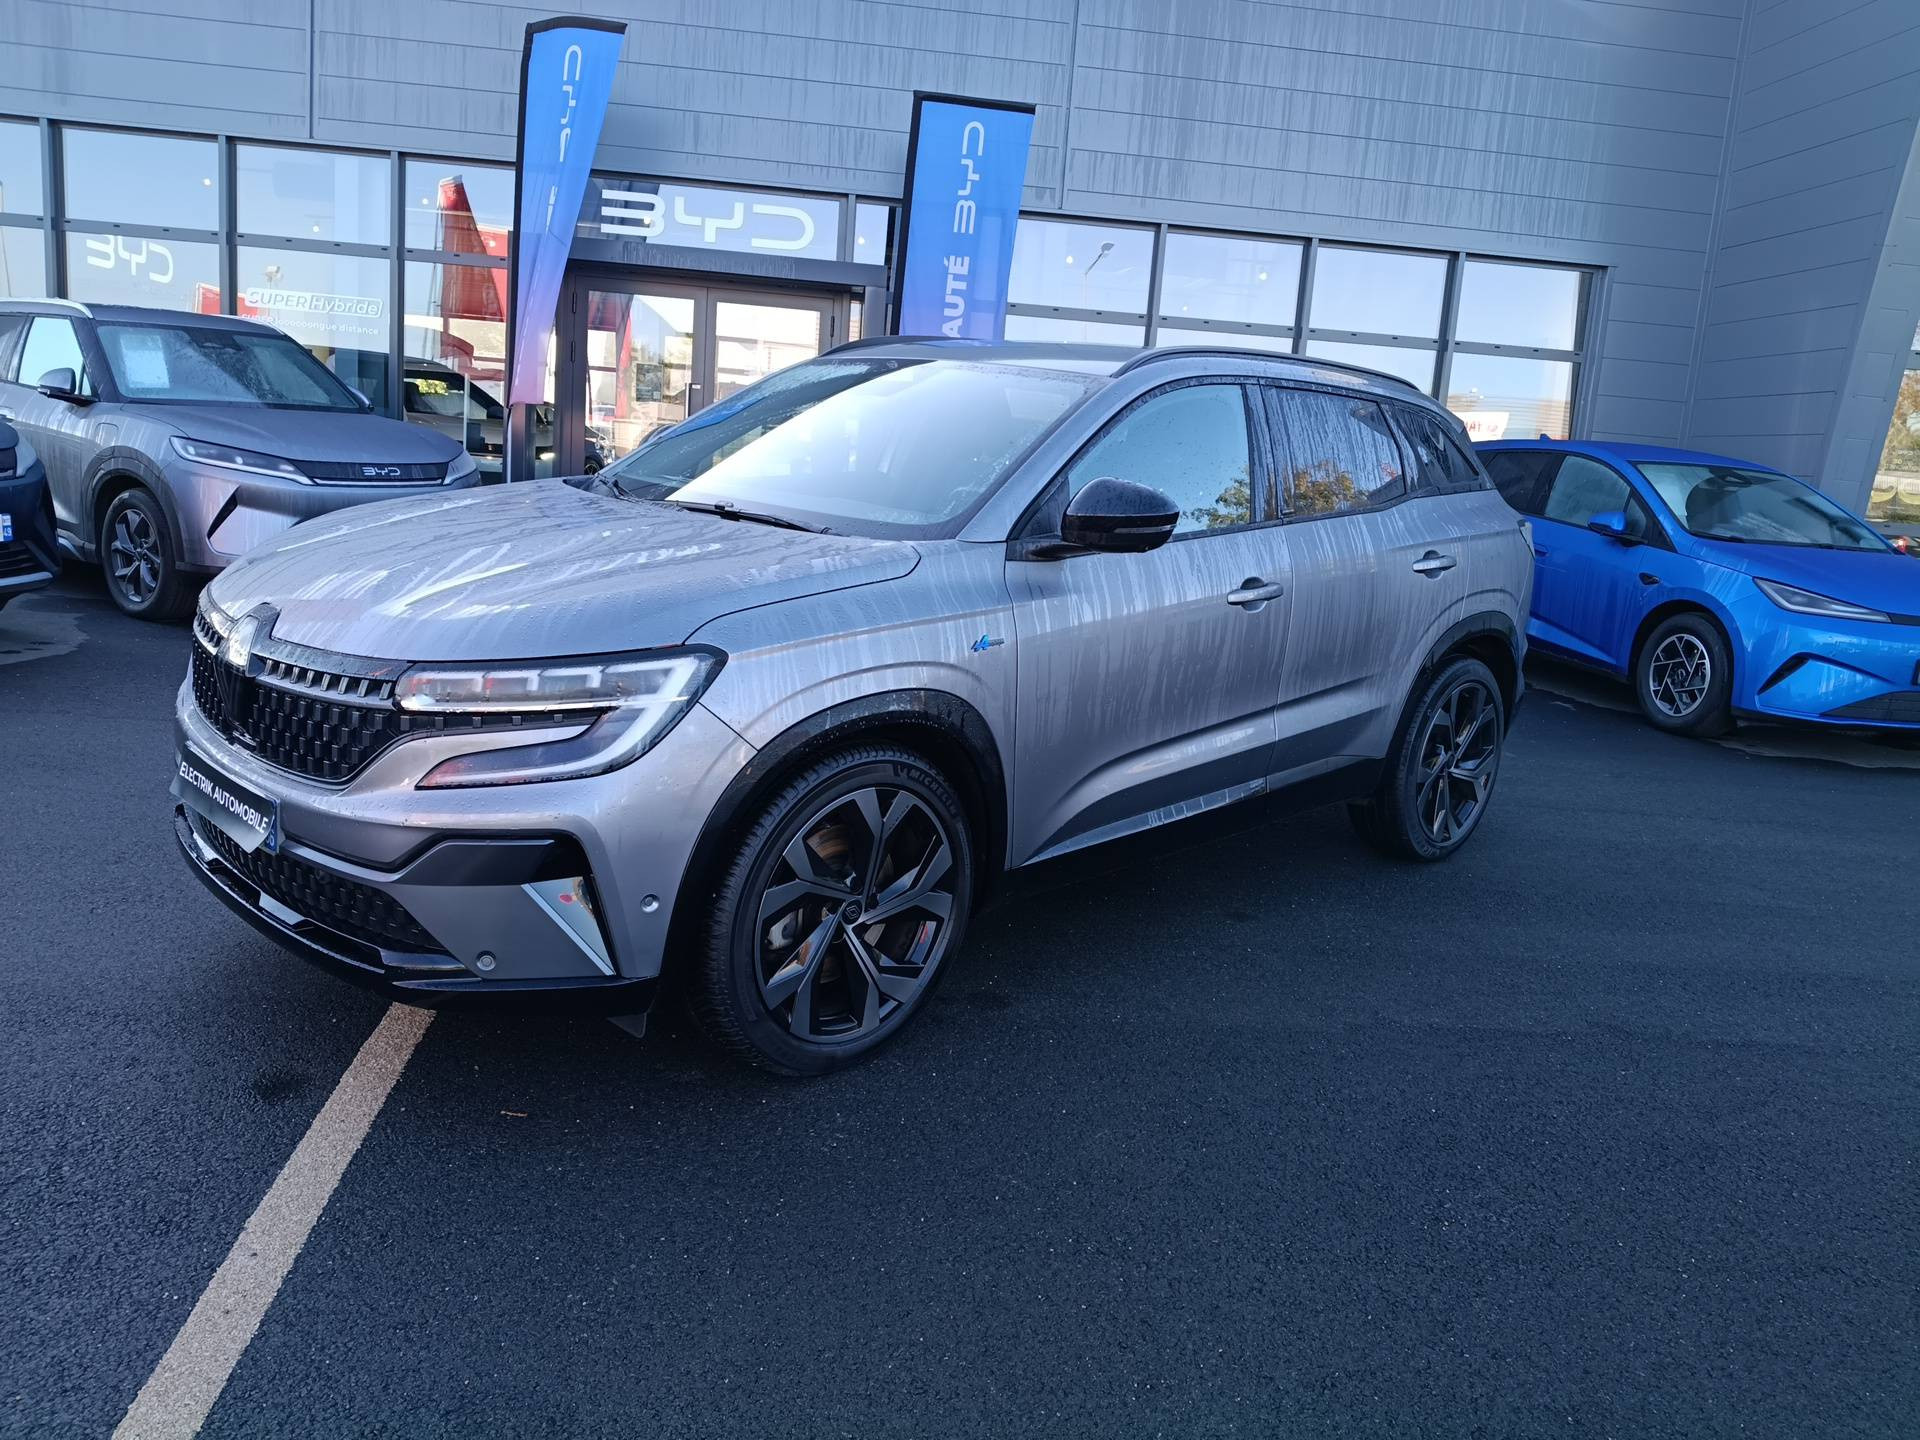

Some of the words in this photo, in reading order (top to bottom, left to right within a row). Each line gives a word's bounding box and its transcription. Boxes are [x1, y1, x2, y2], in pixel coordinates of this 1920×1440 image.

[953, 121, 985, 235] BYD
[600, 188, 815, 250] BYD
[86, 234, 174, 284] BYD
[249, 291, 307, 308] SUPER
[310, 296, 379, 315] Hybride
[339, 323, 379, 335] distance
[362, 466, 401, 476] BYD
[180, 762, 214, 797] ELECTRIK
[212, 786, 269, 833] AUTOMOBILE
